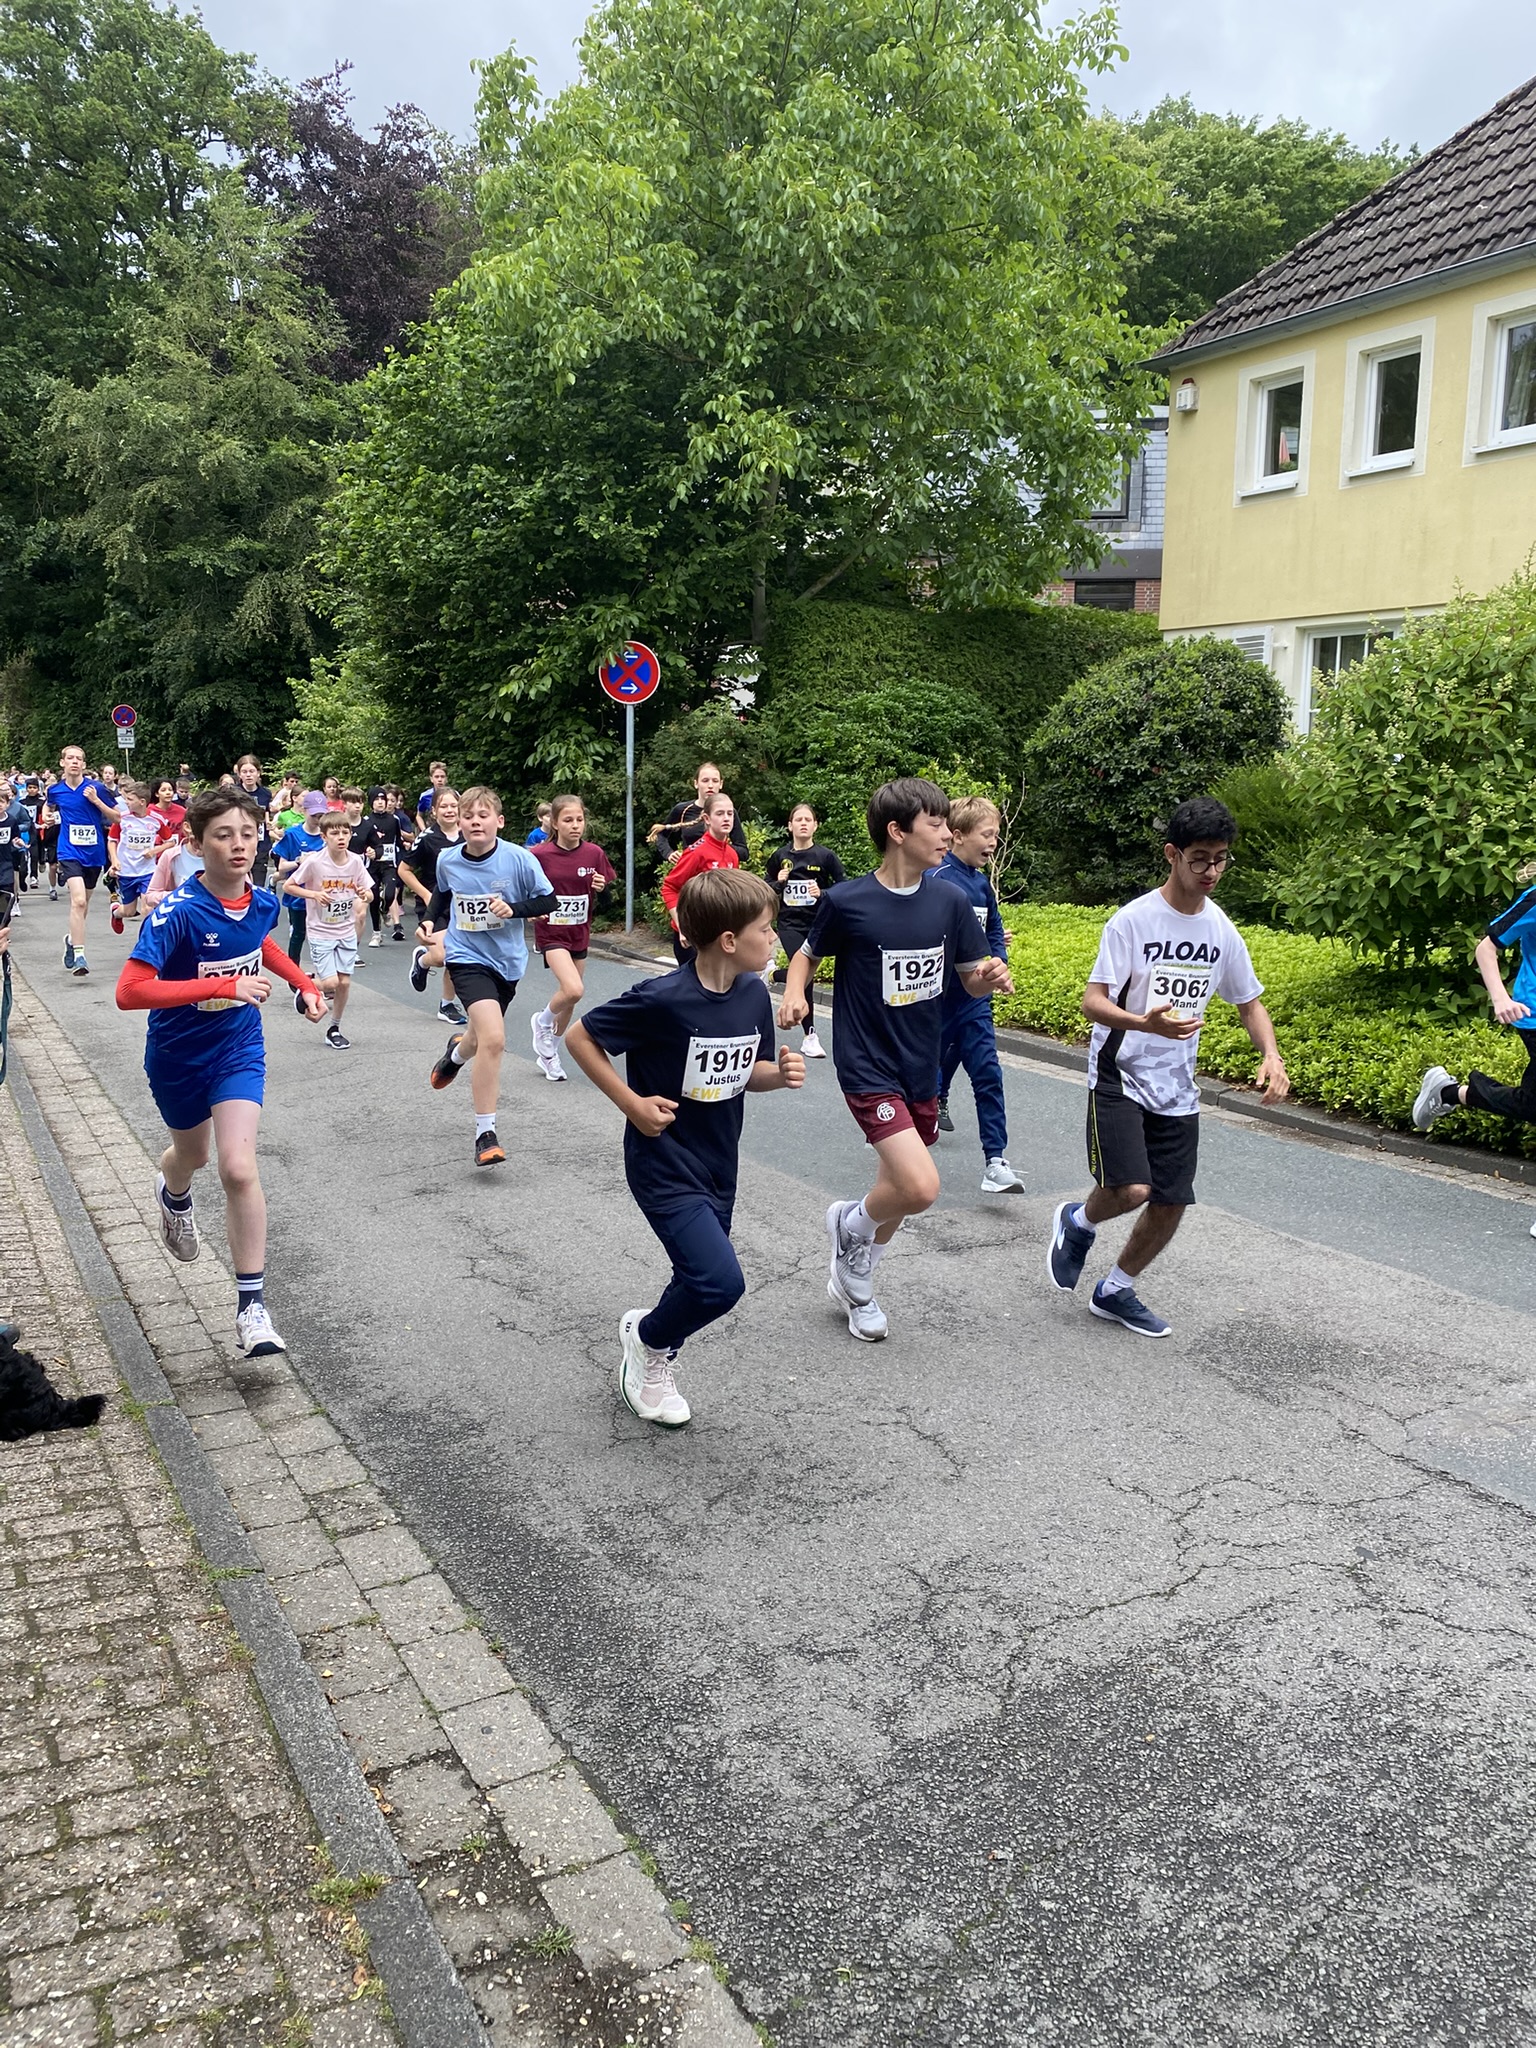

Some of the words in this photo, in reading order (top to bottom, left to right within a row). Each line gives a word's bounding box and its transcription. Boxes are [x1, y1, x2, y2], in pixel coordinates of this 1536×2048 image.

[128, 836, 151, 844] 3522
[328, 900, 353, 912] 1295
[458, 900, 492, 915] 182
[889, 955, 944, 981] 1922
[1153, 976, 1210, 998] 3062
[891, 992, 917, 1005] EWE
[1169, 998, 1198, 1008] Mand
[694, 1046, 753, 1073] 1919
[705, 1074, 741, 1085] Justus
[691, 1087, 722, 1100] EWE
